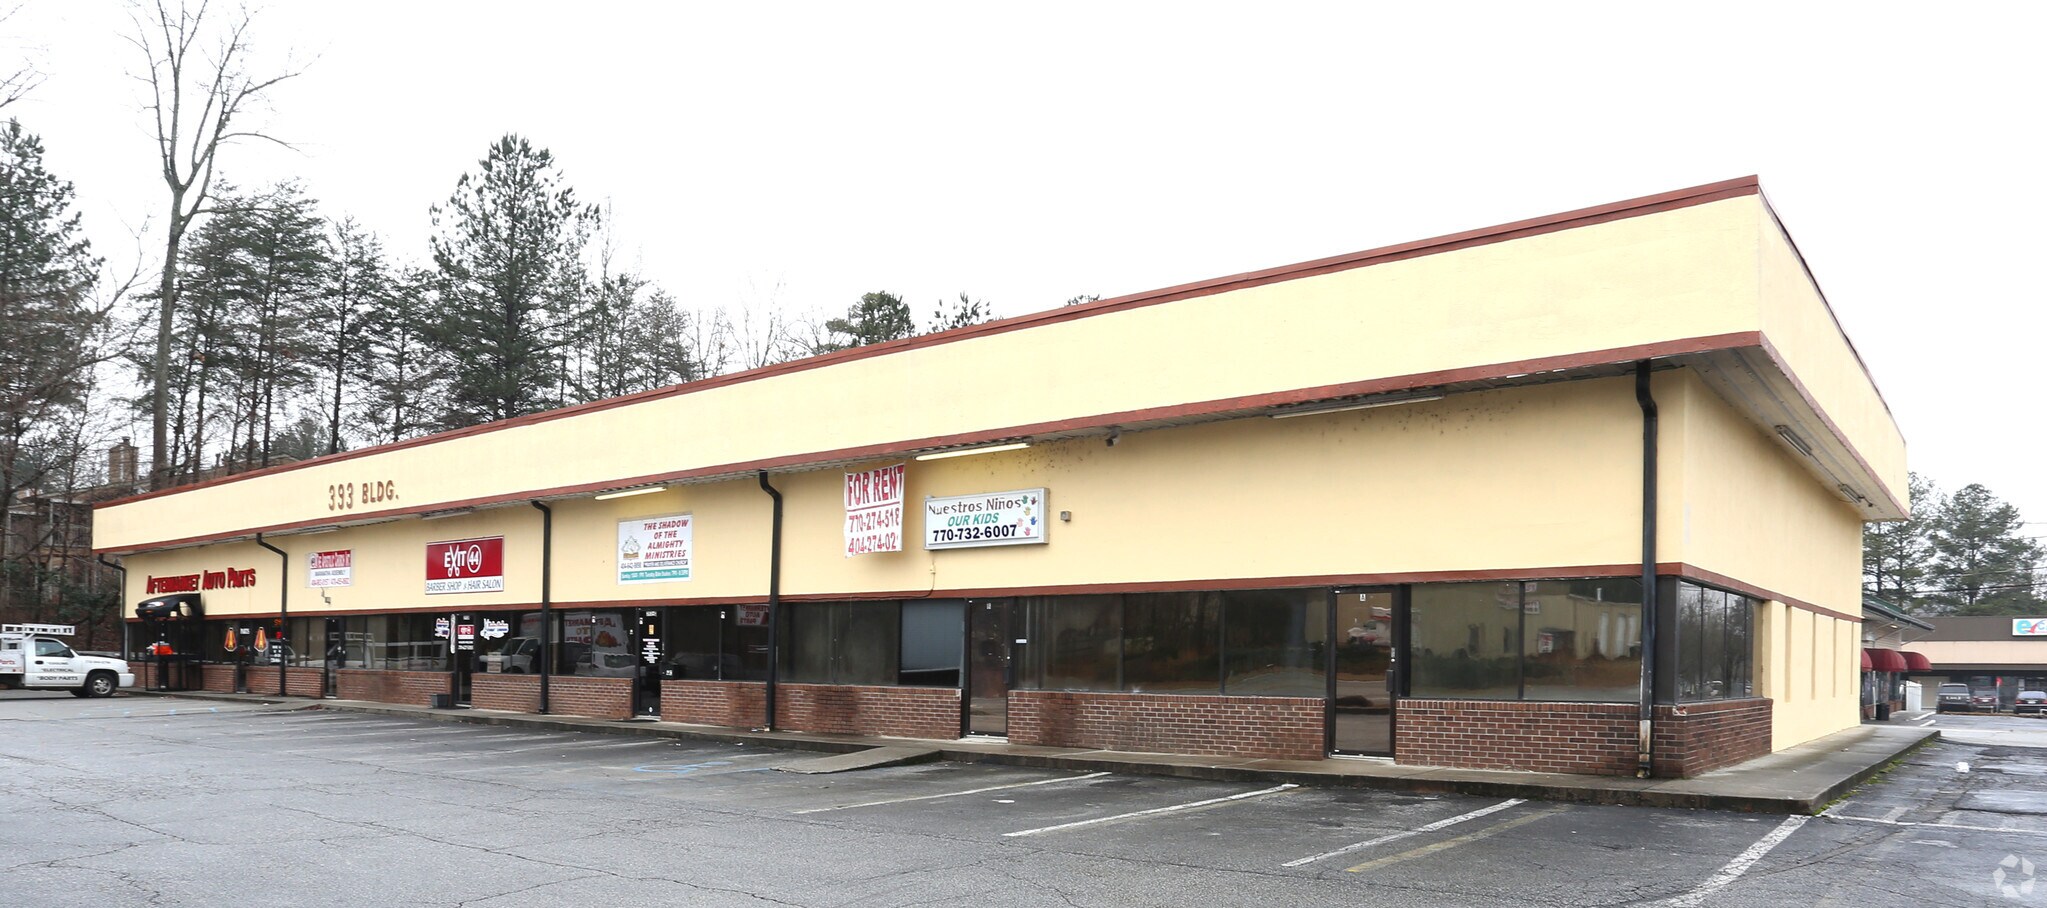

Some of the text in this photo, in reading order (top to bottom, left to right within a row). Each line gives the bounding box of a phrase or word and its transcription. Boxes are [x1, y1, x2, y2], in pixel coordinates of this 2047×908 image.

[847, 465, 904, 506] FOR RENT
[328, 480, 399, 511] 393 BLDG.
[928, 501, 982, 516] Nuestros
[658, 520, 689, 530] SHADOW
[947, 513, 999, 527] OUR KIDS
[654, 530, 677, 540] OF THE
[933, 524, 1017, 542] 770-732-6007
[648, 540, 684, 550] ALMIGHTY
[444, 544, 478, 577] EXIT 44
[645, 550, 686, 560] MINISTRIES
[202, 570, 226, 590] AUTO
[228, 568, 256, 588] PARTS
[426, 582, 446, 592] BARBER
[446, 581, 462, 592] SHOP
[468, 580, 480, 590] HAIR
[482, 578, 502, 590] SALON
